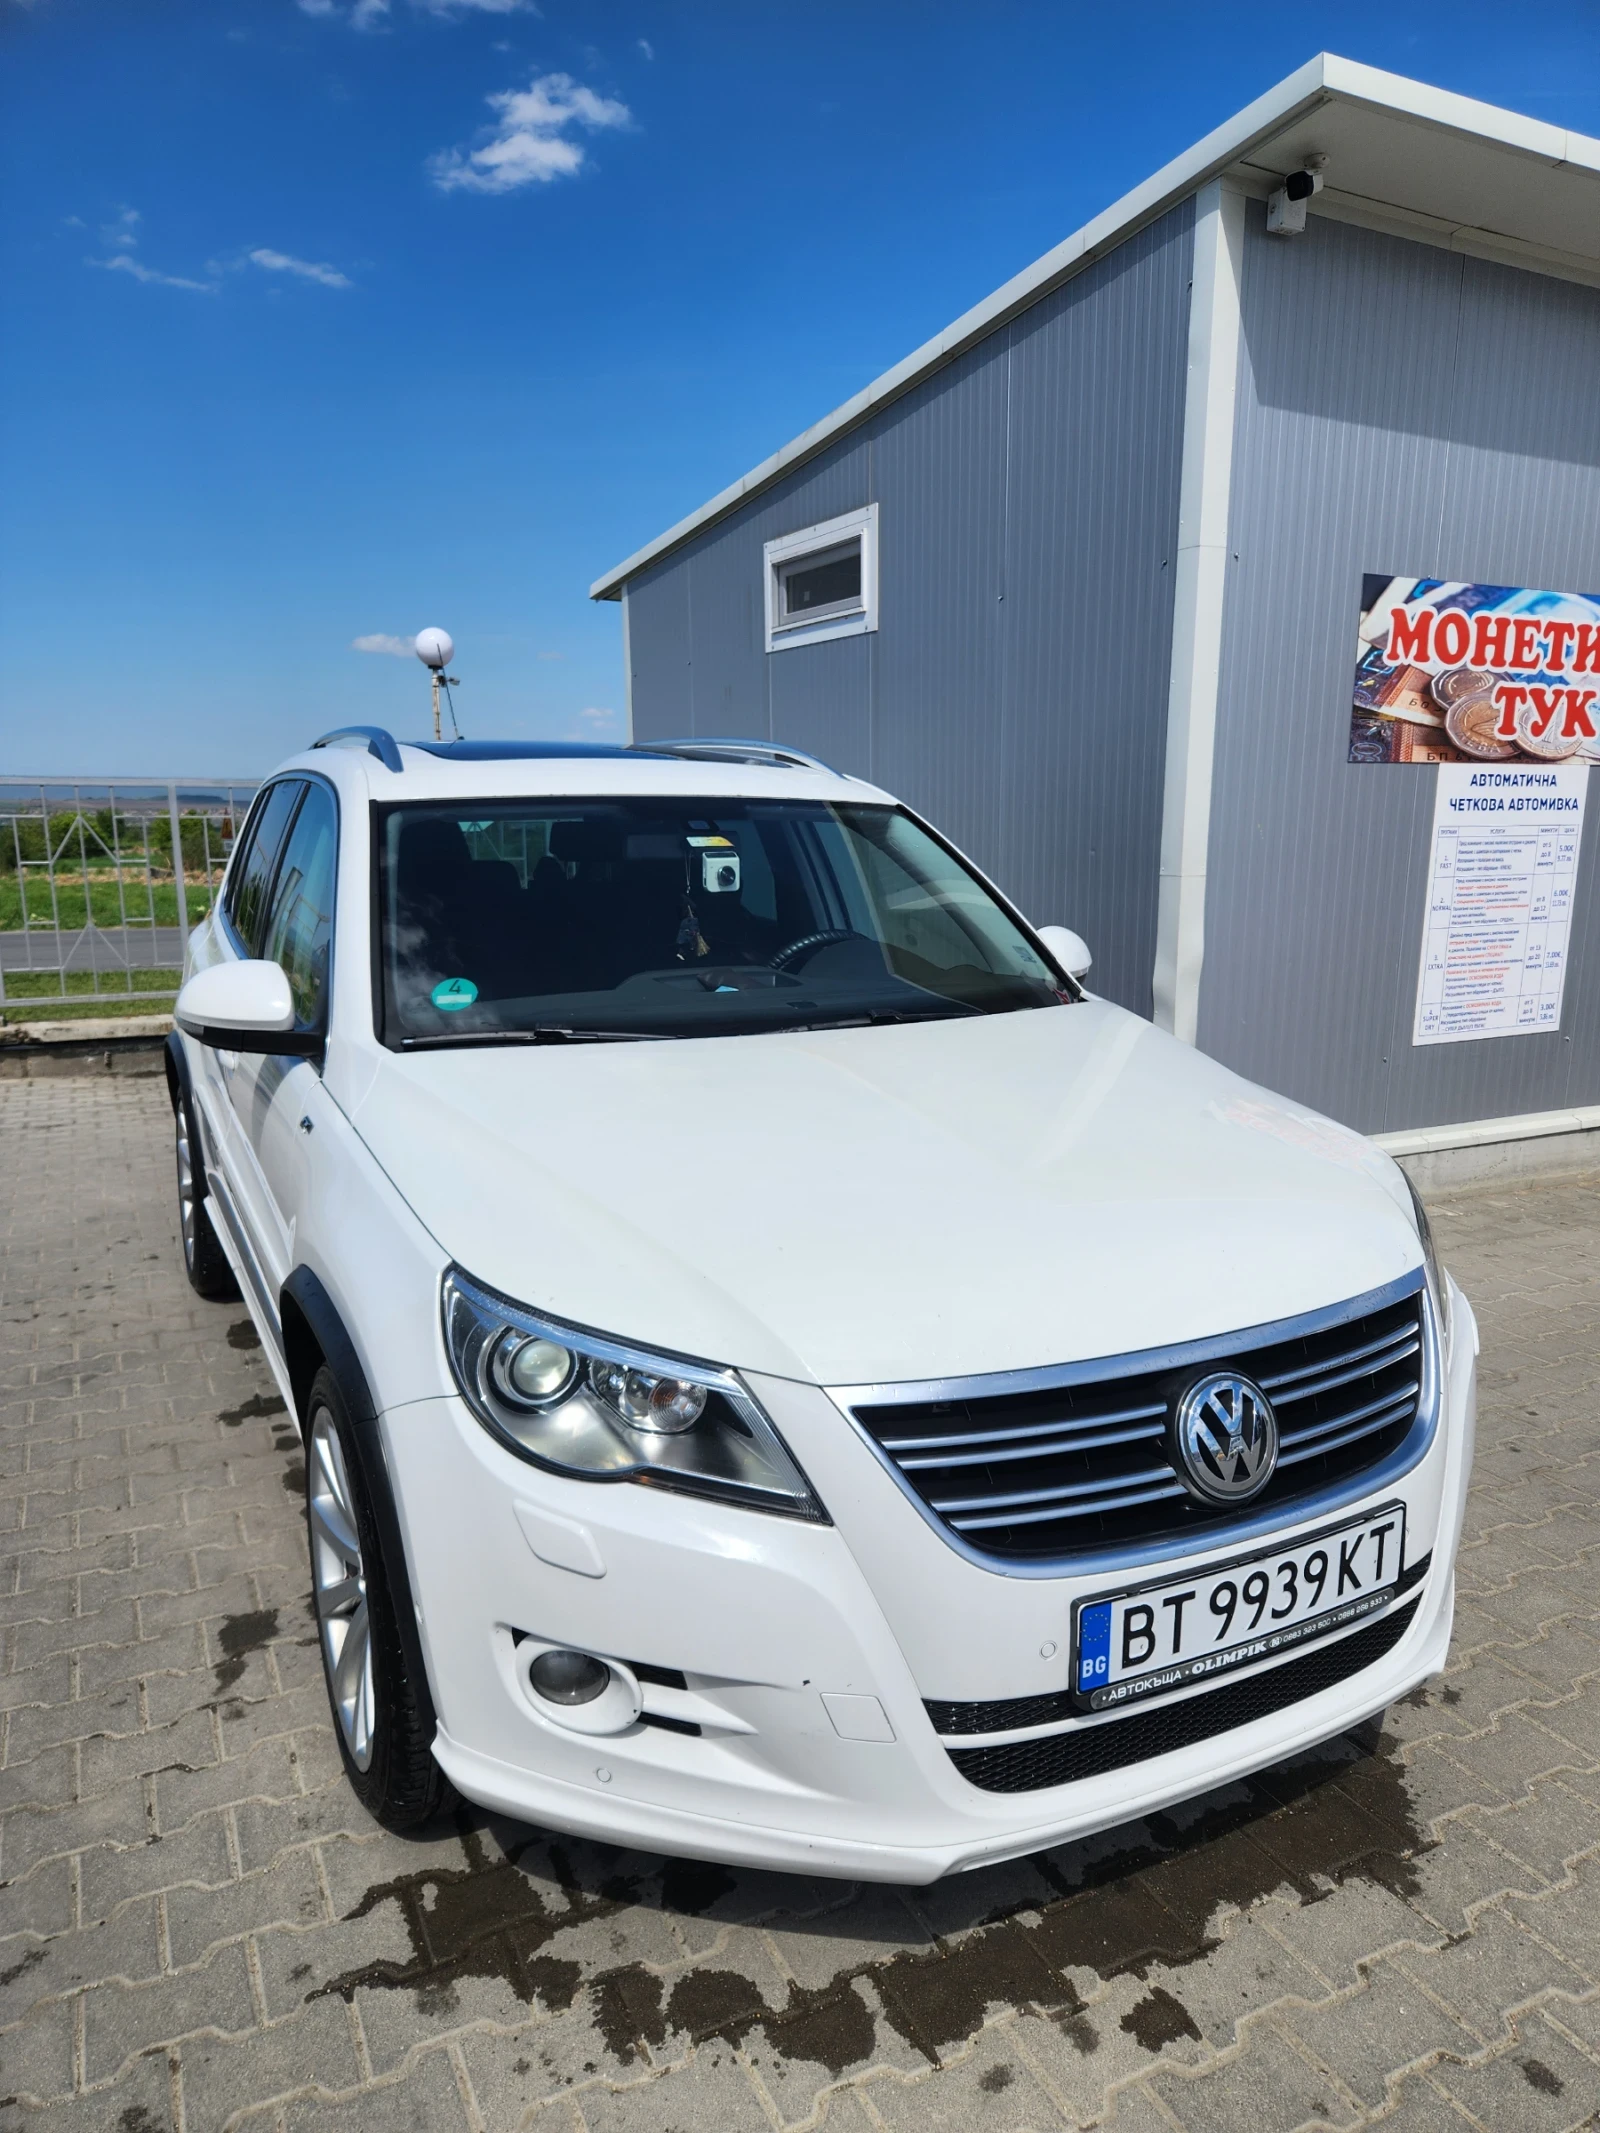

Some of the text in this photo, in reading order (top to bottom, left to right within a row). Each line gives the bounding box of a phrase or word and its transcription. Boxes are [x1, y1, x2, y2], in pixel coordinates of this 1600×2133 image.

[1386, 608, 1600, 673] МОНЕТИ
[1495, 685, 1597, 738] ТУК
[1469, 773, 1558, 788] АВТОМАТИЧНА
[1449, 797, 1579, 812] ЧЕТКОВА АВТОМИВКА
[449, 979, 462, 994] 4
[1209, 1550, 1329, 1642] 9939
[1337, 1521, 1395, 1596] KT
[1082, 1656, 1107, 1679] BG
[1108, 1670, 1182, 1702] АВТОКЪЩА
[1192, 1640, 1267, 1674] OLIMPIK
